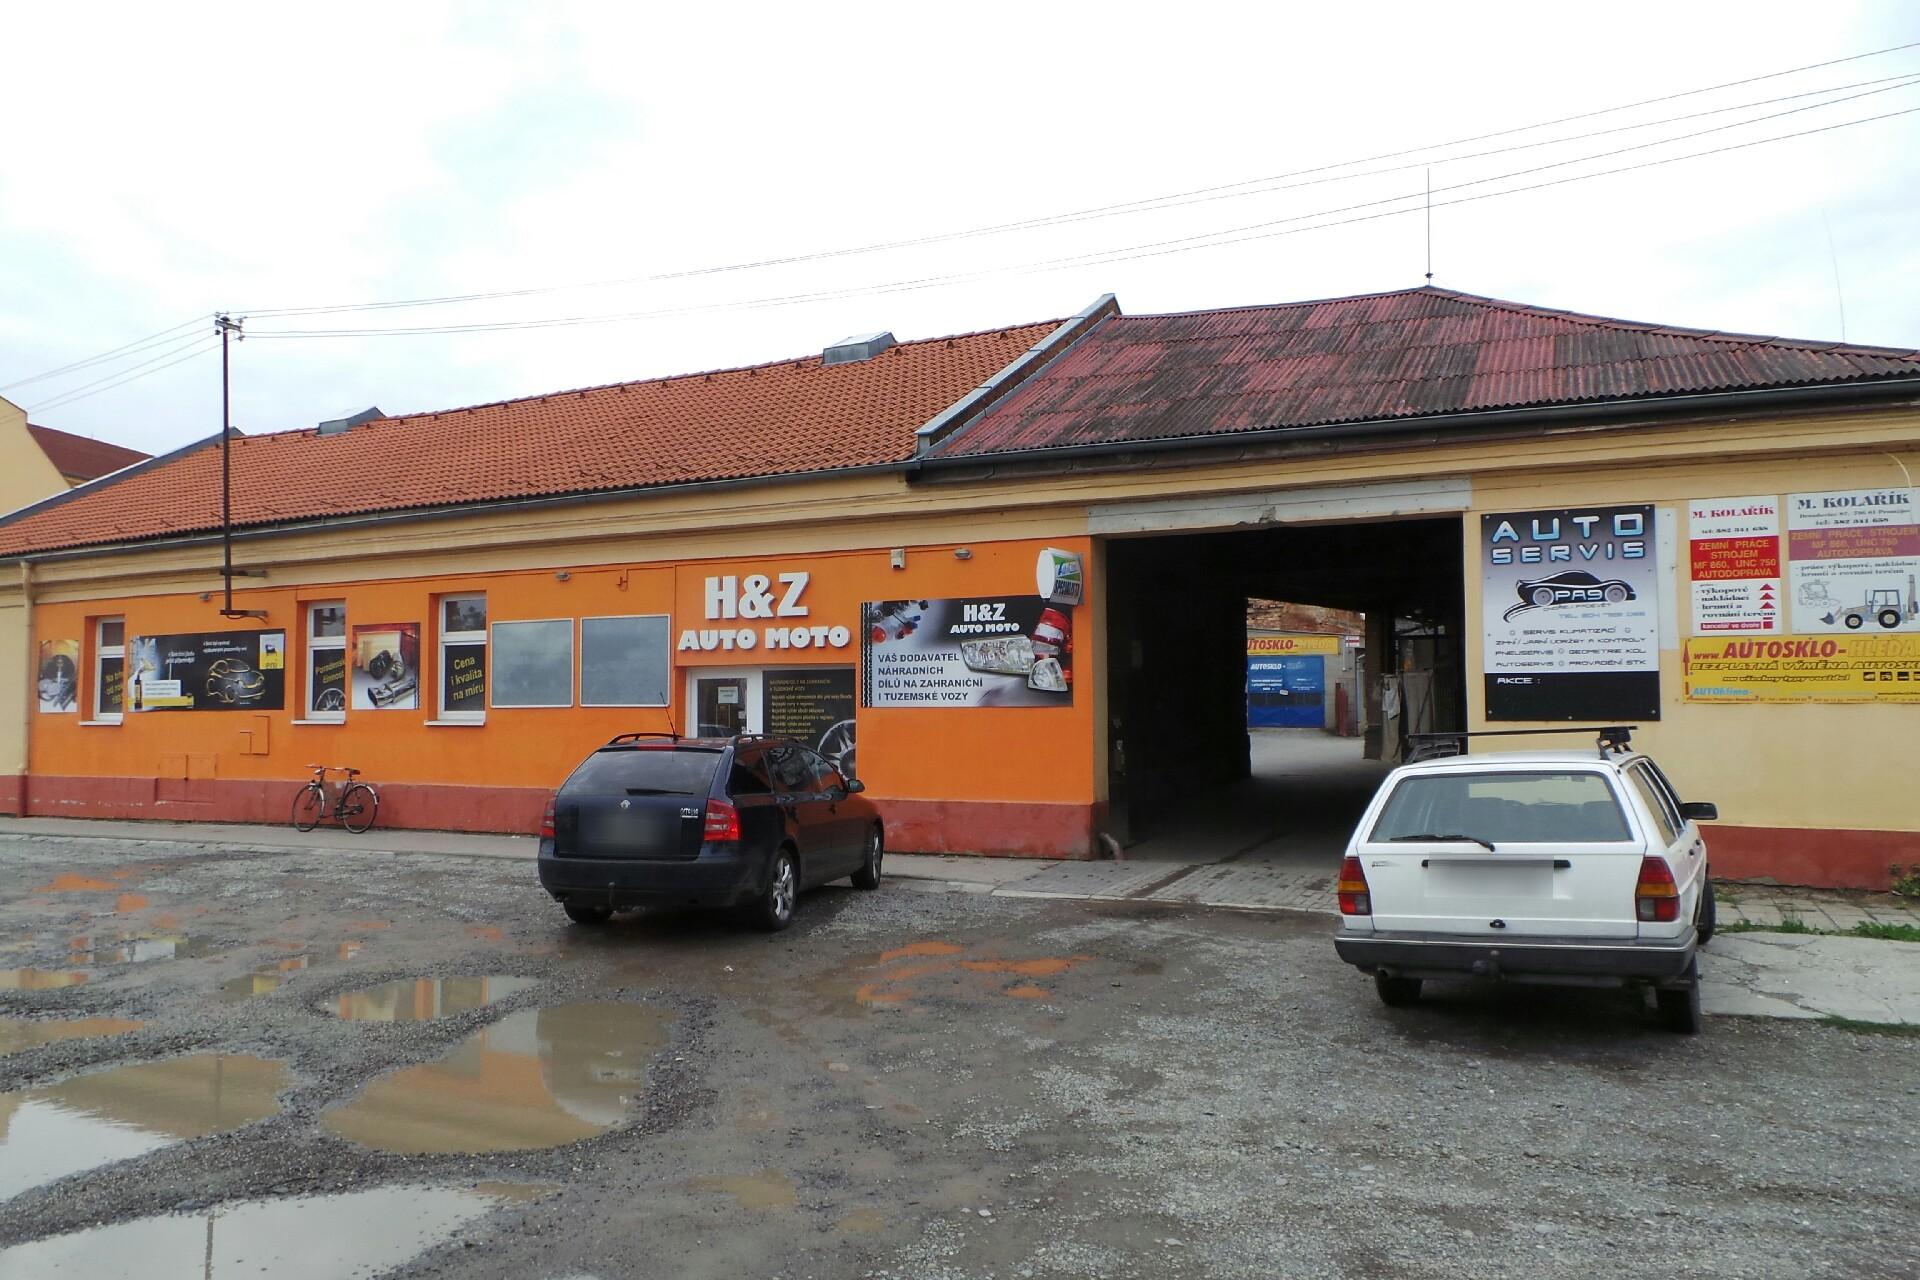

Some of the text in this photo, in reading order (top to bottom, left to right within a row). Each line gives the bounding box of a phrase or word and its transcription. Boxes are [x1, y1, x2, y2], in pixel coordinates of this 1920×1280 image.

[1797, 491, 1910, 510] M. KOLAŘÍK
[1692, 505, 1774, 519] M. KOLAŘÍK
[1492, 513, 1645, 543] AUTO
[1869, 527, 1919, 536] STROJEM
[1698, 539, 1770, 551] ZEMNÍ PRÁCE
[1492, 542, 1645, 564] SERVIS
[1710, 550, 1759, 560] STROJEM
[1816, 547, 1895, 558] AUTODOPRAVA
[1694, 561, 1709, 569] MF
[1735, 559, 1758, 568] UNC
[1760, 558, 1777, 567] 750
[1698, 568, 1773, 579] AUTODOPRAVA
[705, 571, 810, 619] H&Z
[963, 603, 1006, 622] H&Z
[950, 622, 1021, 635] AUTO MOTO
[677, 625, 851, 650] AUTO MOTO
[1597, 636, 1647, 644] KONTROLY
[453, 656, 476, 670] Cena
[878, 652, 960, 663] VÁŠ DODAVATEL
[1690, 660, 1779, 670] BEZPLATNÁ
[1783, 659, 1849, 670] VÝMĚNA
[455, 669, 483, 684] kvalita
[878, 666, 944, 676] NÁHRADNÍCH
[878, 677, 984, 689] DÍLŮ NA ZAHRANIČNÍ
[1497, 677, 1534, 685] AKCE
[453, 684, 484, 702] na míru
[883, 691, 938, 702] TUZEMSKÉ
[940, 692, 969, 701] VOZY
